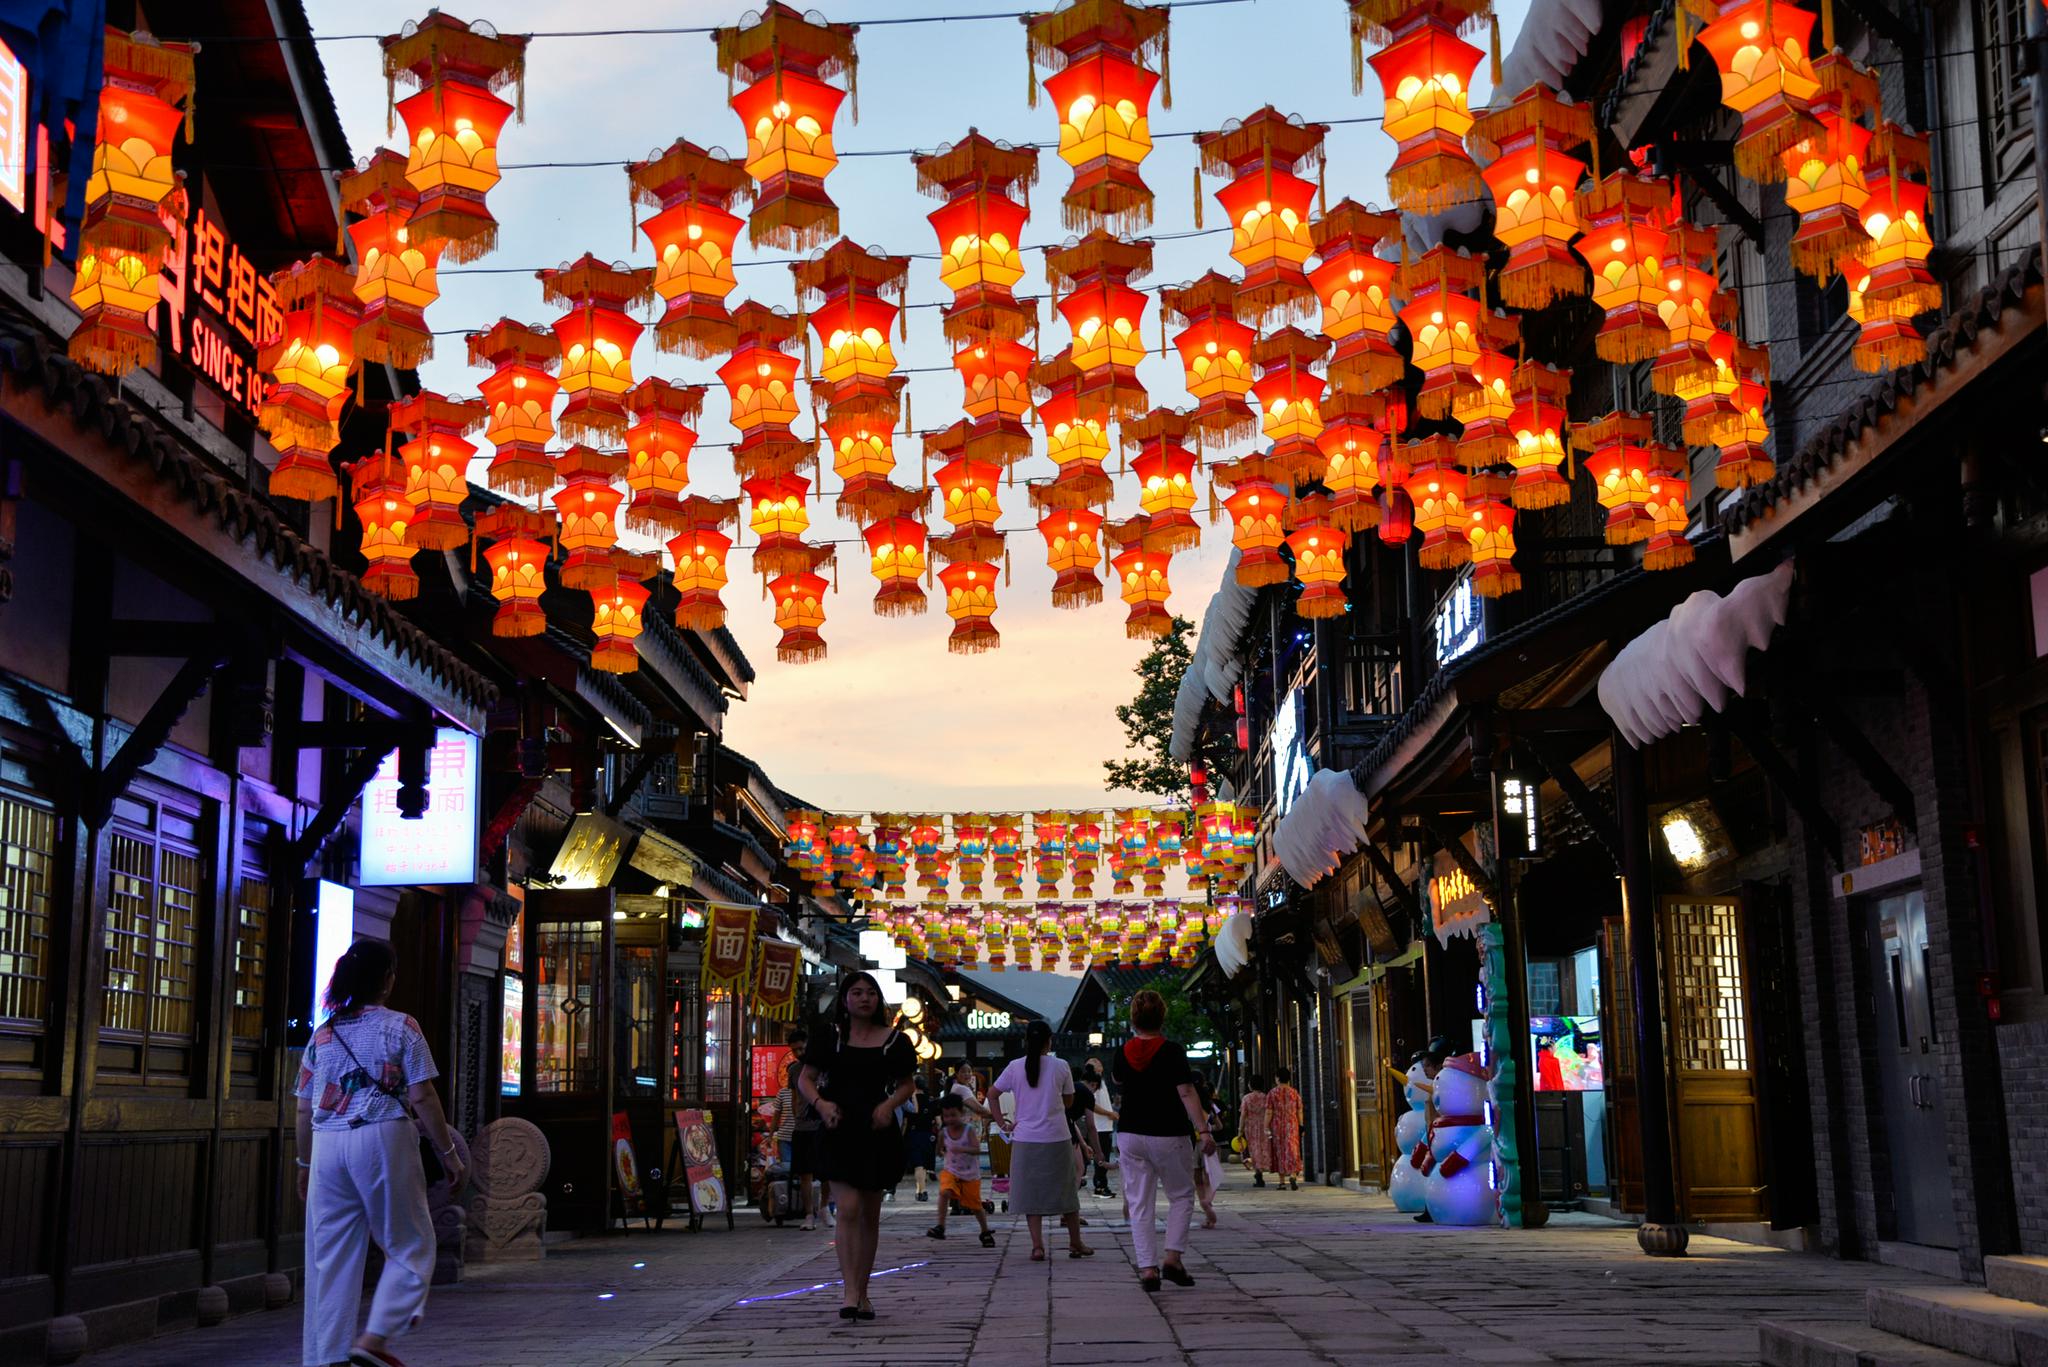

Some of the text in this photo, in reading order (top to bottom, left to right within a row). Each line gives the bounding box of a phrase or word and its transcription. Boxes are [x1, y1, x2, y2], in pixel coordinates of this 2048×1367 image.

[191, 317, 270, 417] SINCE 19
[374, 787, 464, 813] 担面
[716, 926, 746, 962] 面
[765, 960, 792, 992] 面
[967, 1009, 1010, 1029] dicos
